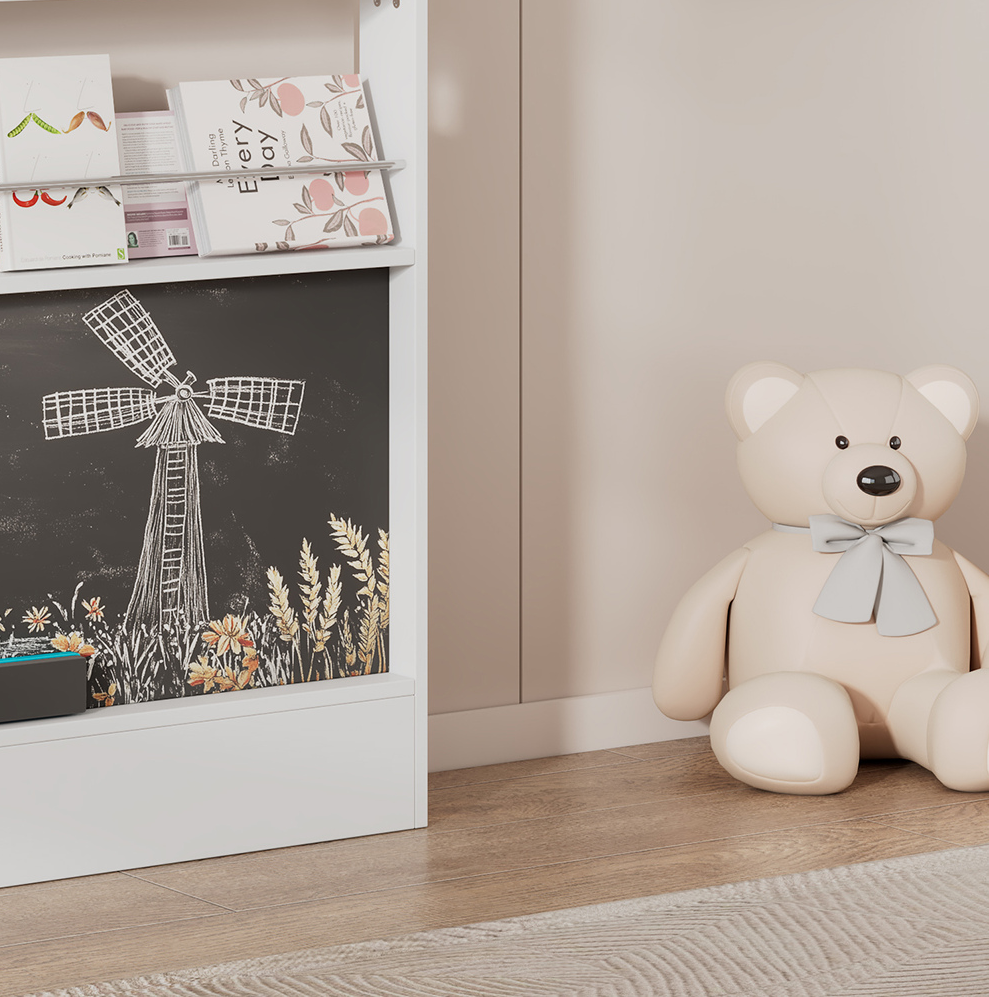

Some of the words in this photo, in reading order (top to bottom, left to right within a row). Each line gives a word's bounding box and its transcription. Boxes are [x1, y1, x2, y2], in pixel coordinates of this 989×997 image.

[208, 133, 220, 167] Darling
[217, 127, 229, 156] Thyme
[232, 119, 259, 193] Eery
[281, 129, 290, 160] Galloway
[223, 159, 234, 188] Leon
